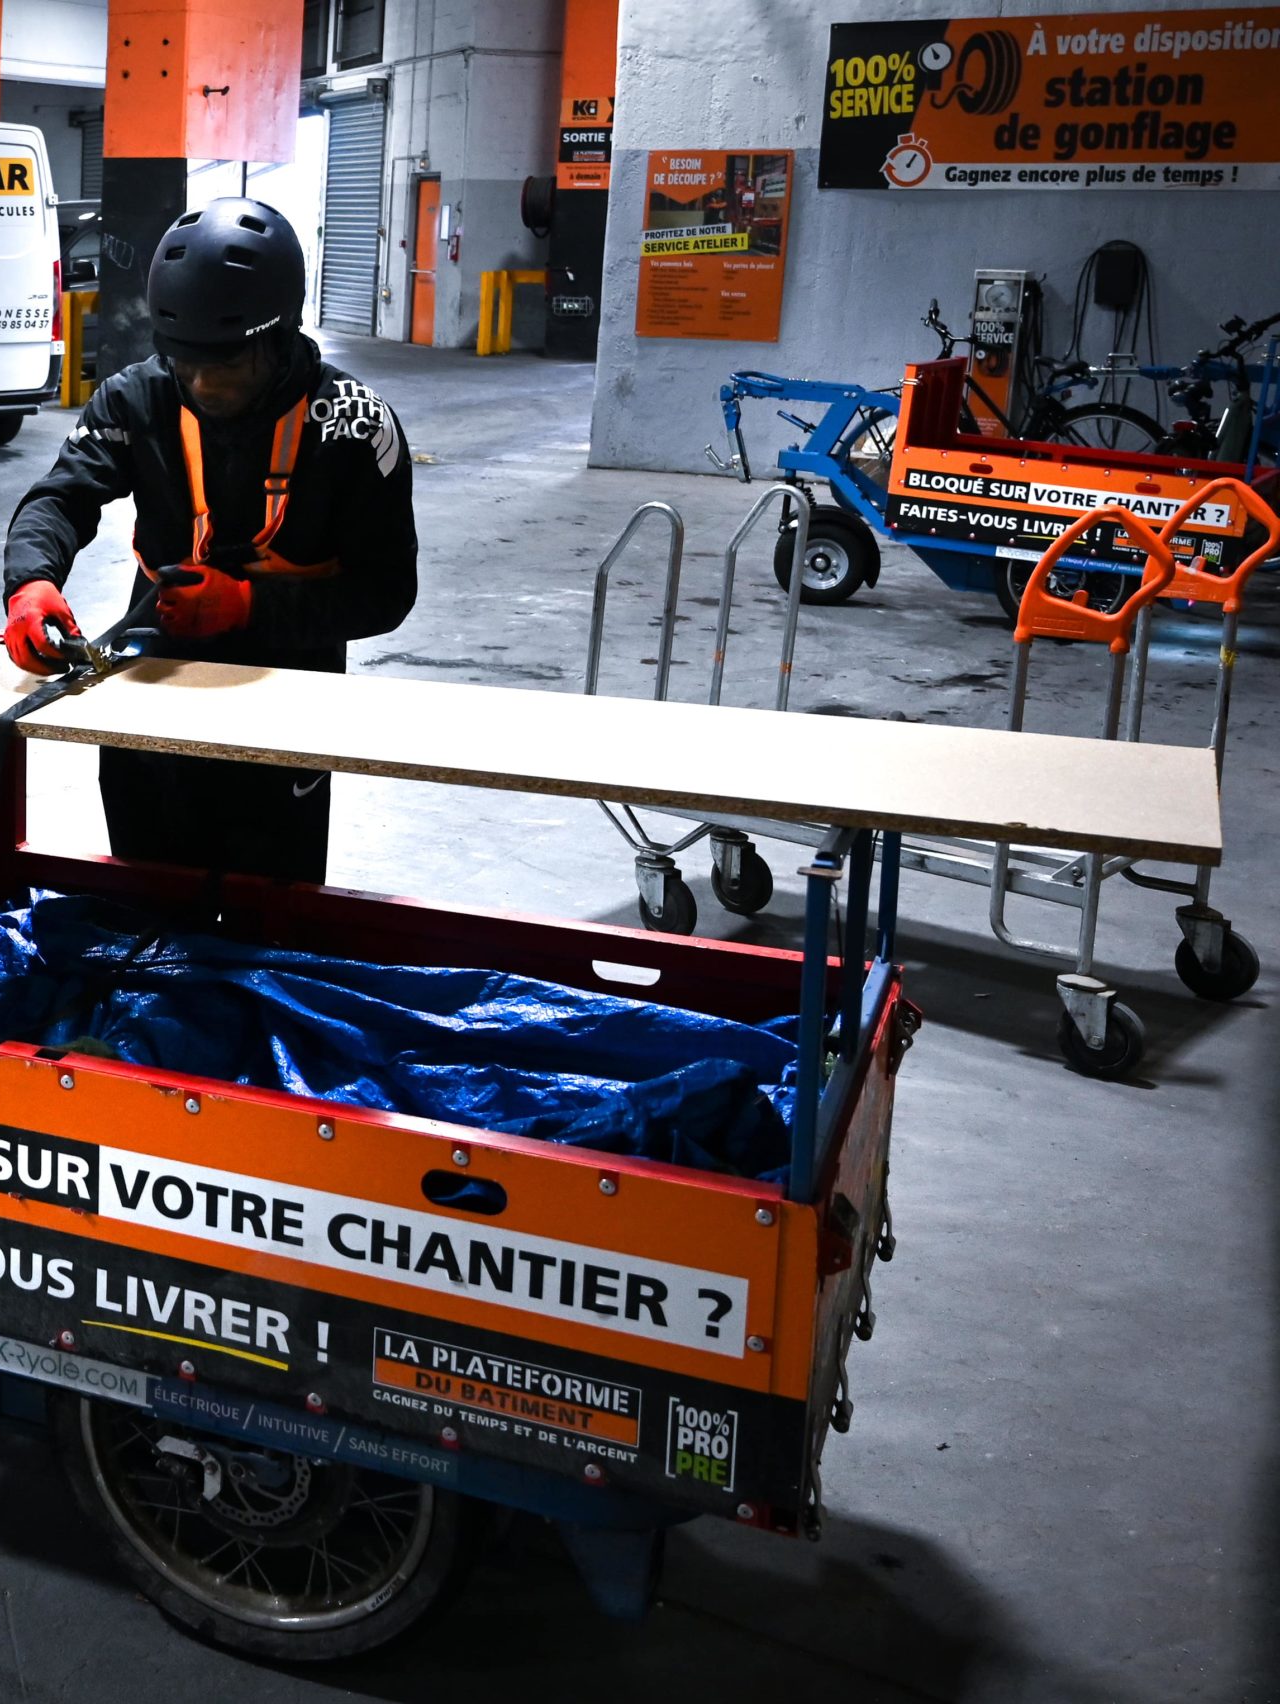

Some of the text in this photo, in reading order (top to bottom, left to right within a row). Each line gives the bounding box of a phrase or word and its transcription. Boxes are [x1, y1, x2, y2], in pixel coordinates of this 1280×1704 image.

[1026, 22, 1048, 57] À
[1056, 27, 1125, 56] votre
[829, 50, 916, 89] 100%
[1043, 63, 1204, 108] station
[829, 83, 915, 119] SERVICE
[563, 132, 606, 143] SORTIE
[993, 111, 1237, 161] de gonflage
[654, 171, 715, 185] DE DÉCOUPE ?
[670, 157, 701, 171] BESOIN
[944, 165, 1239, 187] Gagnez encore plus de temps !
[644, 241, 690, 253] SERVICE
[693, 237, 738, 250] ATELIER
[645, 225, 727, 240] PROFITEZ DE NOTRE
[10, 320, 22, 329] 85
[24, 320, 37, 329] 04
[39, 320, 49, 329] 37
[975, 320, 1005, 333] 100%
[908, 472, 983, 495] BLOQUÉ
[990, 482, 1028, 500] SUR
[1034, 487, 1097, 508] VOTRE
[1214, 509, 1225, 523] ?
[899, 502, 1018, 531] FAITES-VOUS
[1095, 528, 1102, 541] !
[109, 1163, 305, 1247] VOTRE
[327, 1212, 668, 1327] CHANTIER
[697, 1288, 733, 1339] ?
[95, 1268, 290, 1355] LIVRER
[316, 1320, 330, 1364] !
[384, 1335, 630, 1414] LA PLATEFORME
[415, 1371, 594, 1430] DU BATIMENT
[153, 1384, 241, 1422] ÉLECTRIQUE
[257, 1414, 330, 1444] INTUITIVE
[349, 1436, 388, 1460] SANS
[391, 1448, 450, 1474] EFFORT
[372, 1389, 638, 1464] GAGNEZ DU TEMPS ET DE L'ARGENT
[675, 1404, 730, 1437] 100%
[677, 1425, 729, 1460] PRO
[675, 1450, 728, 1486] PRE
